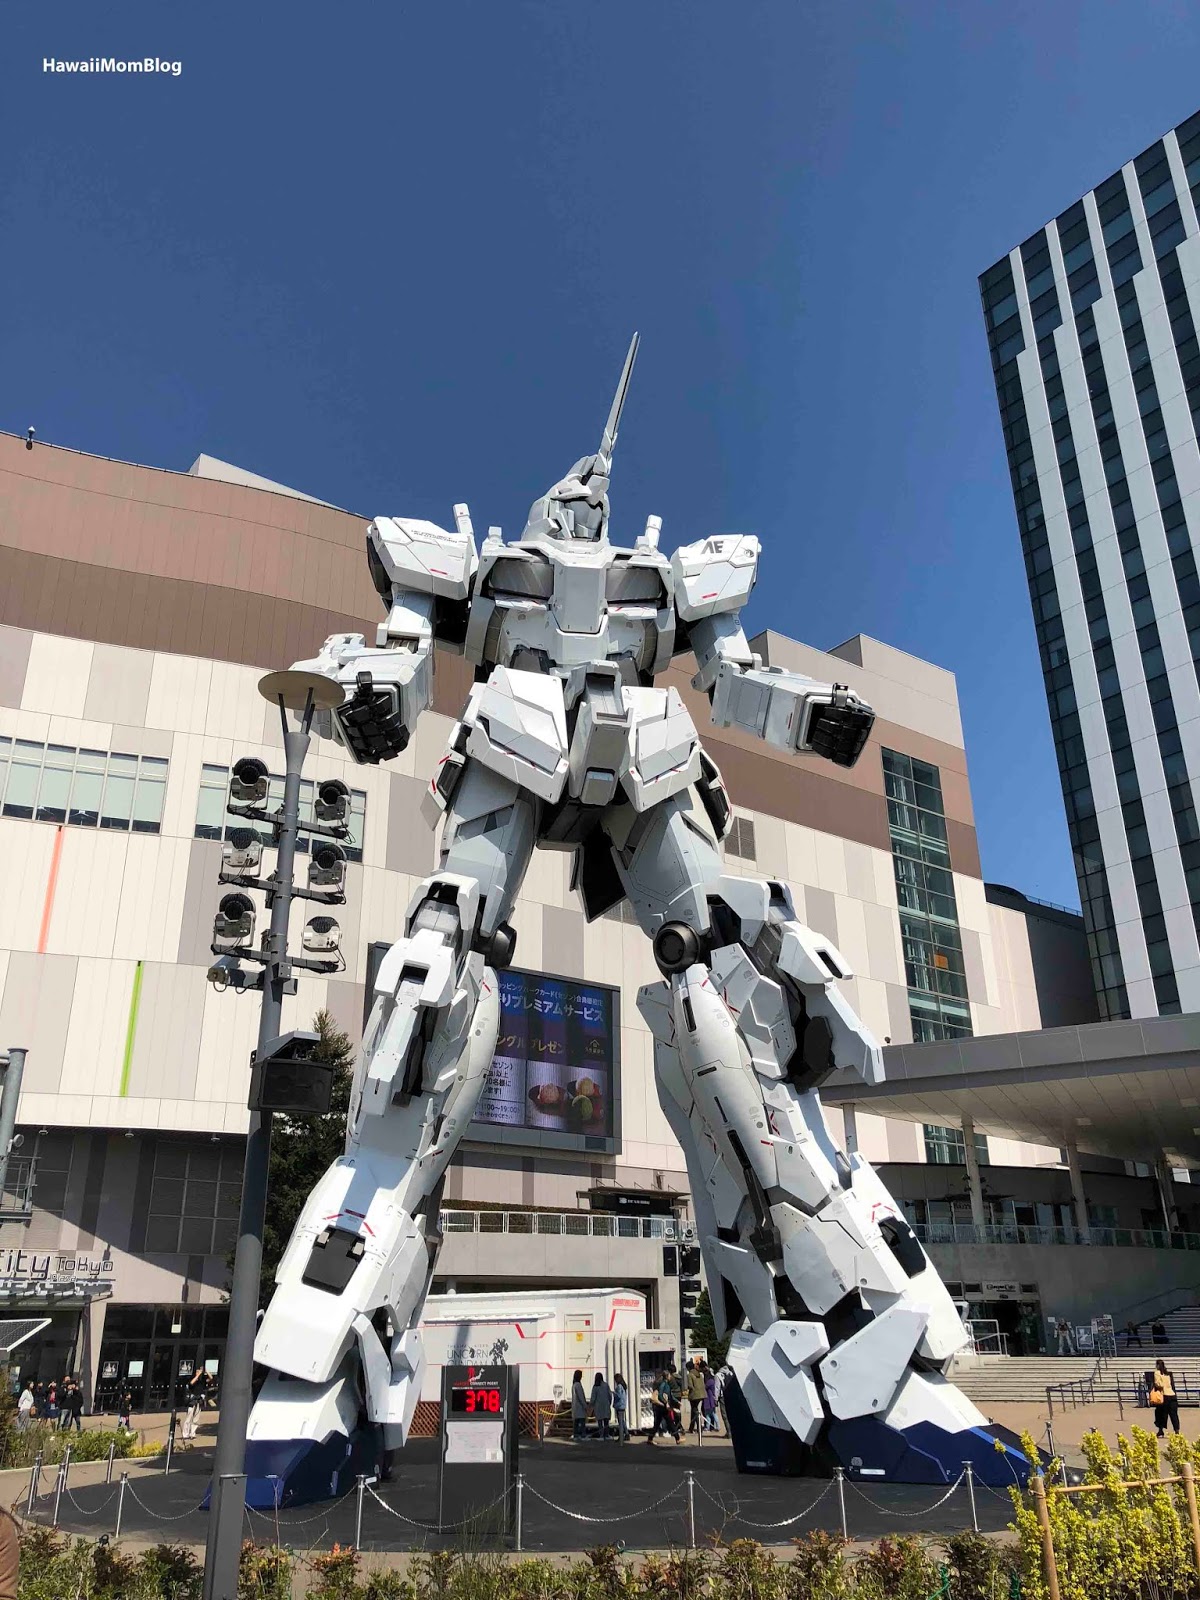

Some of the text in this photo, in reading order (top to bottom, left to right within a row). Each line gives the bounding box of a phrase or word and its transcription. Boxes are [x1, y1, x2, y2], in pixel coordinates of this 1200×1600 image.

[0, 1249, 114, 1280] ity Tokyo
[466, 1390, 500, 1413] 378
